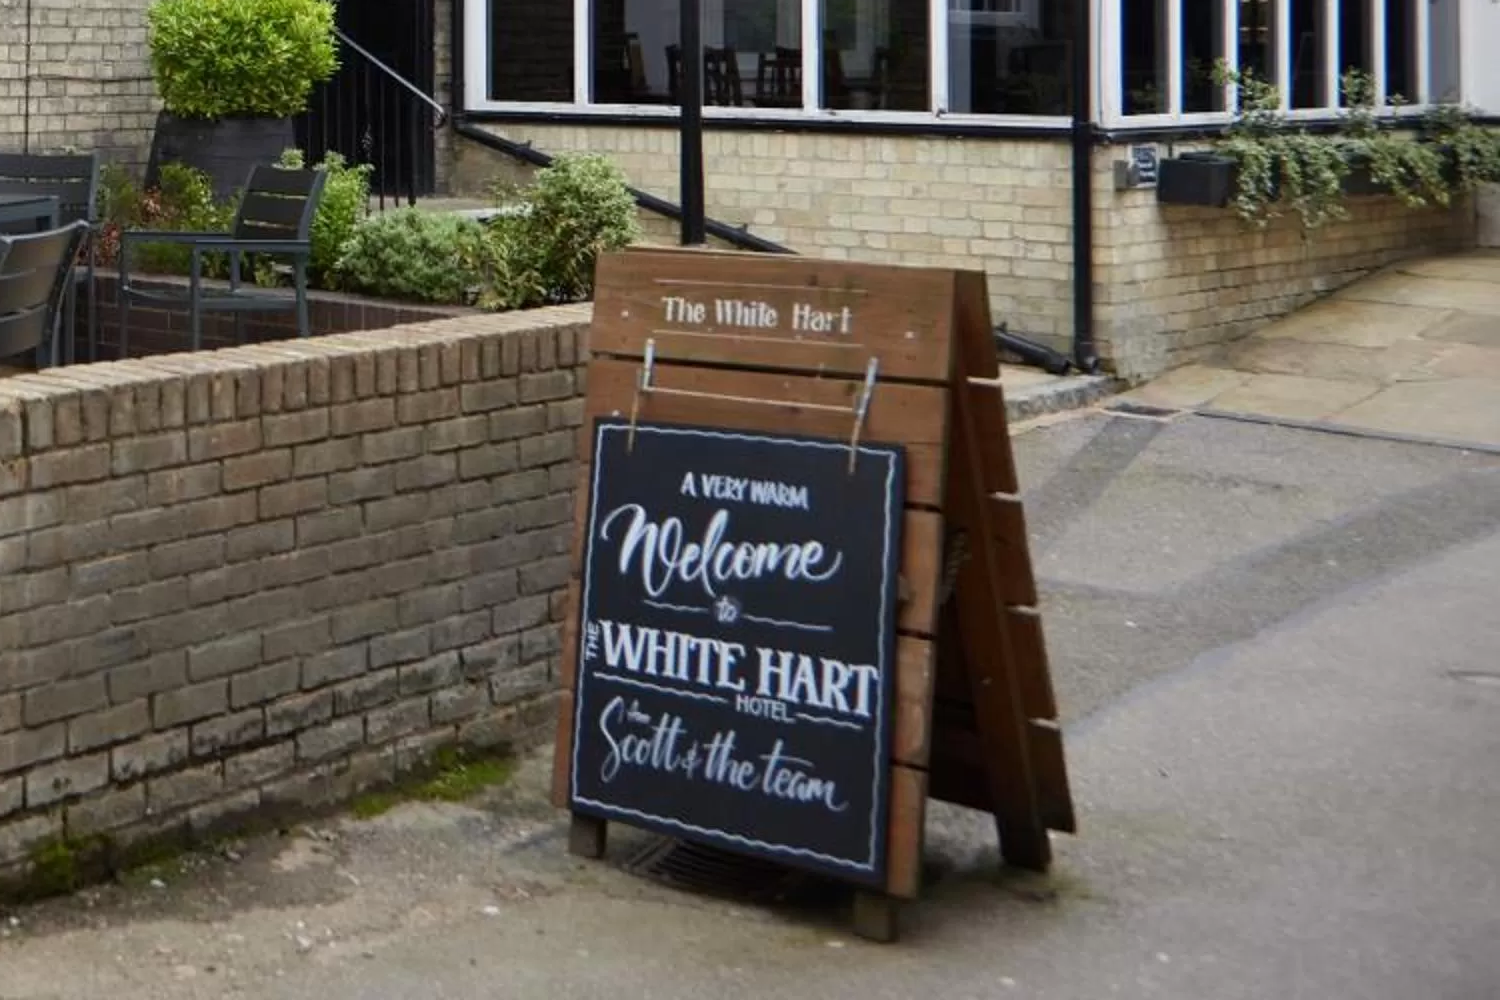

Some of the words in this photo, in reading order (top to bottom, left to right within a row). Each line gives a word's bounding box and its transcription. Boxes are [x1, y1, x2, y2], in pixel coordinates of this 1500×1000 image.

[661, 297, 705, 323] The
[715, 299, 778, 328] White
[791, 303, 852, 334] Hart
[680, 471, 697, 497] A
[701, 474, 747, 502] VERY
[750, 480, 809, 510] WARM
[601, 503, 843, 598] Welcome
[716, 596, 739, 622] to
[585, 621, 599, 660] THE
[598, 619, 746, 691] WHITE
[756, 647, 880, 718] HART
[734, 695, 796, 724] HOTEL
[600, 696, 688, 784] Scott
[677, 741, 702, 779] &
[703, 729, 762, 791] the
[760, 738, 850, 812] team
